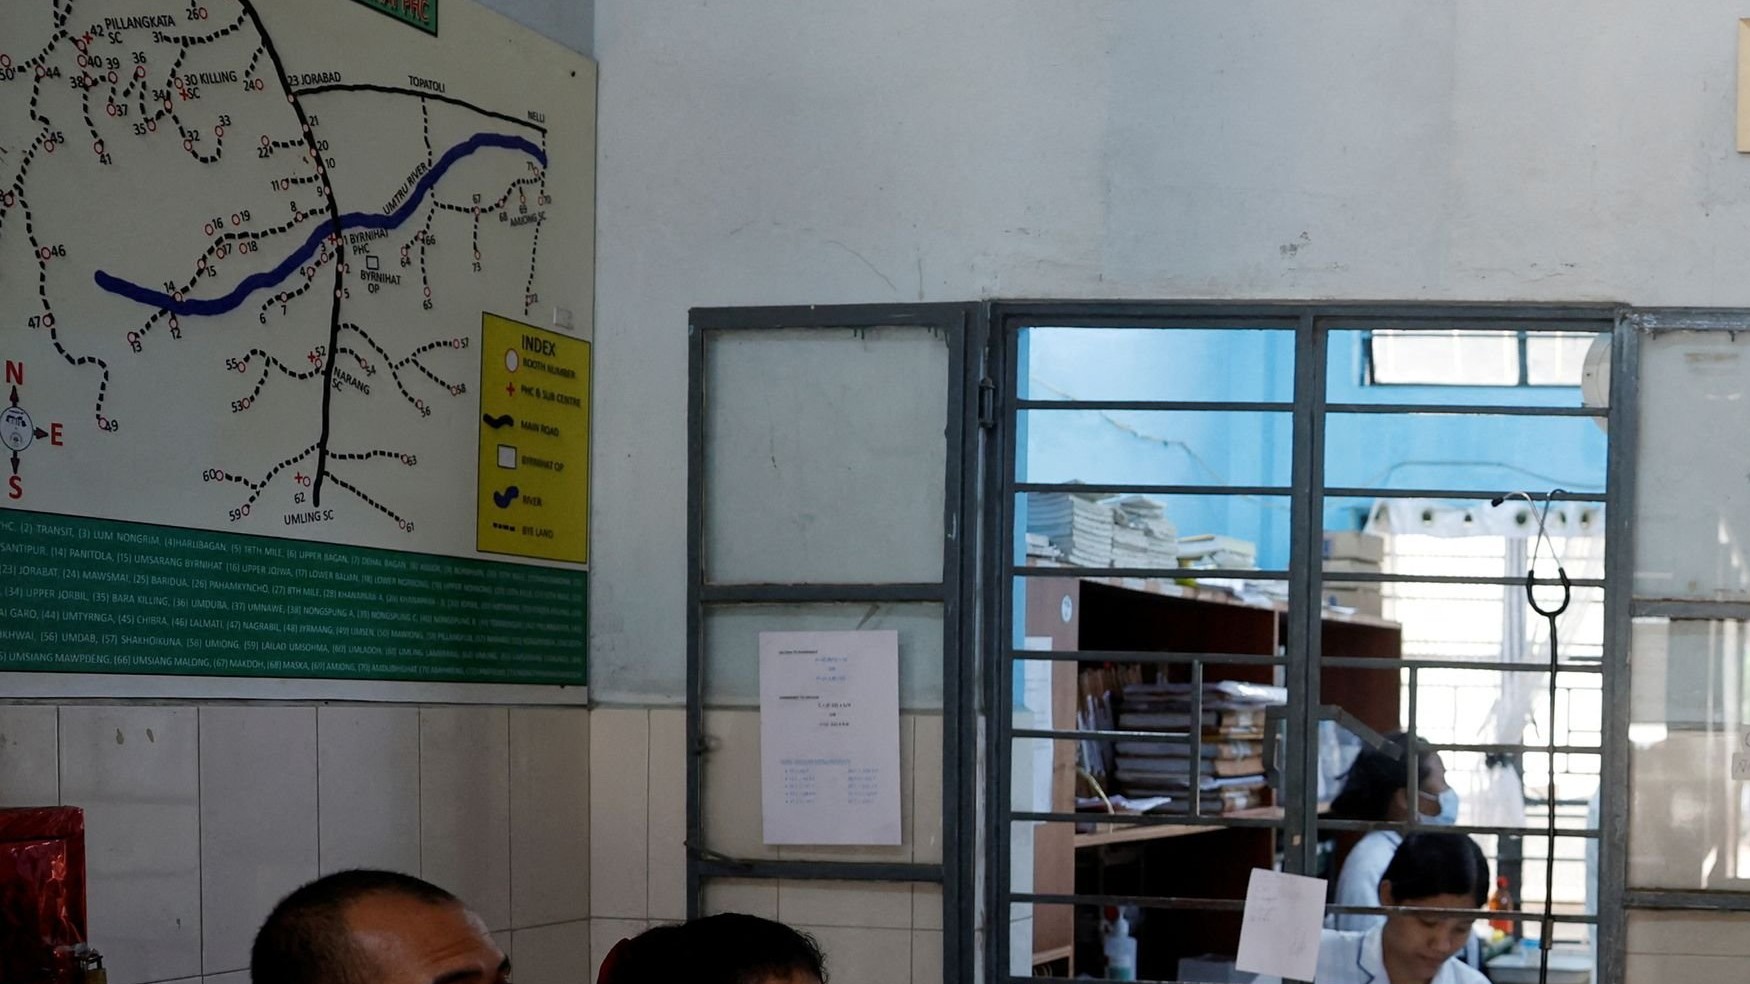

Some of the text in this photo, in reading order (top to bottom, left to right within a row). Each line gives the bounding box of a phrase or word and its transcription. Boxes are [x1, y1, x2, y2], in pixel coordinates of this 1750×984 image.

[187, 9, 199, 20] 26
[105, 16, 175, 30] PILLANGKATA
[90, 26, 104, 37] 42
[109, 32, 122, 44] SC
[153, 32, 165, 43] 31
[87, 56, 102, 68] 40
[107, 57, 120, 69] 39
[132, 52, 145, 63] 36
[46, 68, 61, 78] 44
[184, 71, 237, 85] 30 KILLING
[70, 77, 83, 88] 38
[288, 72, 341, 86] 23 JORABAD
[408, 75, 445, 93] TOPATOLI
[243, 80, 255, 91] 24
[152, 90, 165, 101] 34
[189, 88, 200, 99] SC
[116, 105, 128, 116] 37
[219, 115, 231, 126] 33
[308, 115, 319, 126] 21
[134, 124, 146, 135] 35
[50, 131, 65, 144] 45
[187, 130, 199, 141] 32
[317, 140, 328, 151] 20
[258, 147, 271, 158] 22
[100, 153, 112, 165] 41
[325, 158, 336, 168] 10
[271, 180, 279, 191] 11
[383, 162, 428, 214] UMTRU RIVER
[316, 186, 323, 197] 9
[472, 194, 481, 203] 67
[290, 202, 297, 212] 8
[240, 211, 250, 221] 19
[212, 218, 223, 229] 16
[247, 241, 258, 252] 18
[426, 236, 436, 246] 66
[51, 246, 66, 257] 46
[222, 243, 232, 254] 17
[320, 242, 326, 252] 3
[353, 243, 370, 255] PHC
[401, 257, 410, 267] 64
[472, 263, 481, 272] 73
[205, 266, 217, 277] 15
[300, 267, 305, 277] 4
[361, 270, 400, 285] BYRNIHAT
[163, 281, 175, 292] 14
[368, 283, 380, 293] OP
[423, 300, 432, 309] 65
[281, 306, 287, 315] 7
[28, 317, 41, 328] 47
[260, 313, 266, 324] 6
[171, 328, 181, 340] 12
[131, 341, 142, 353] 13
[461, 338, 469, 347] 57
[522, 334, 556, 356] INDEX
[315, 347, 326, 357] 52
[226, 358, 238, 370] 55
[6, 361, 23, 384] N
[333, 367, 370, 395] NARANG
[333, 379, 343, 392] SC
[457, 384, 466, 394] 58
[232, 401, 243, 412] 53
[421, 406, 431, 417] 56
[106, 421, 118, 432] 49
[51, 424, 63, 446] E
[407, 456, 417, 466] 63
[203, 470, 216, 481] 60
[9, 476, 22, 499] S
[294, 493, 305, 503] 62
[229, 509, 241, 521] 59
[284, 510, 333, 525] UMLING SC
[406, 522, 414, 532] 61
